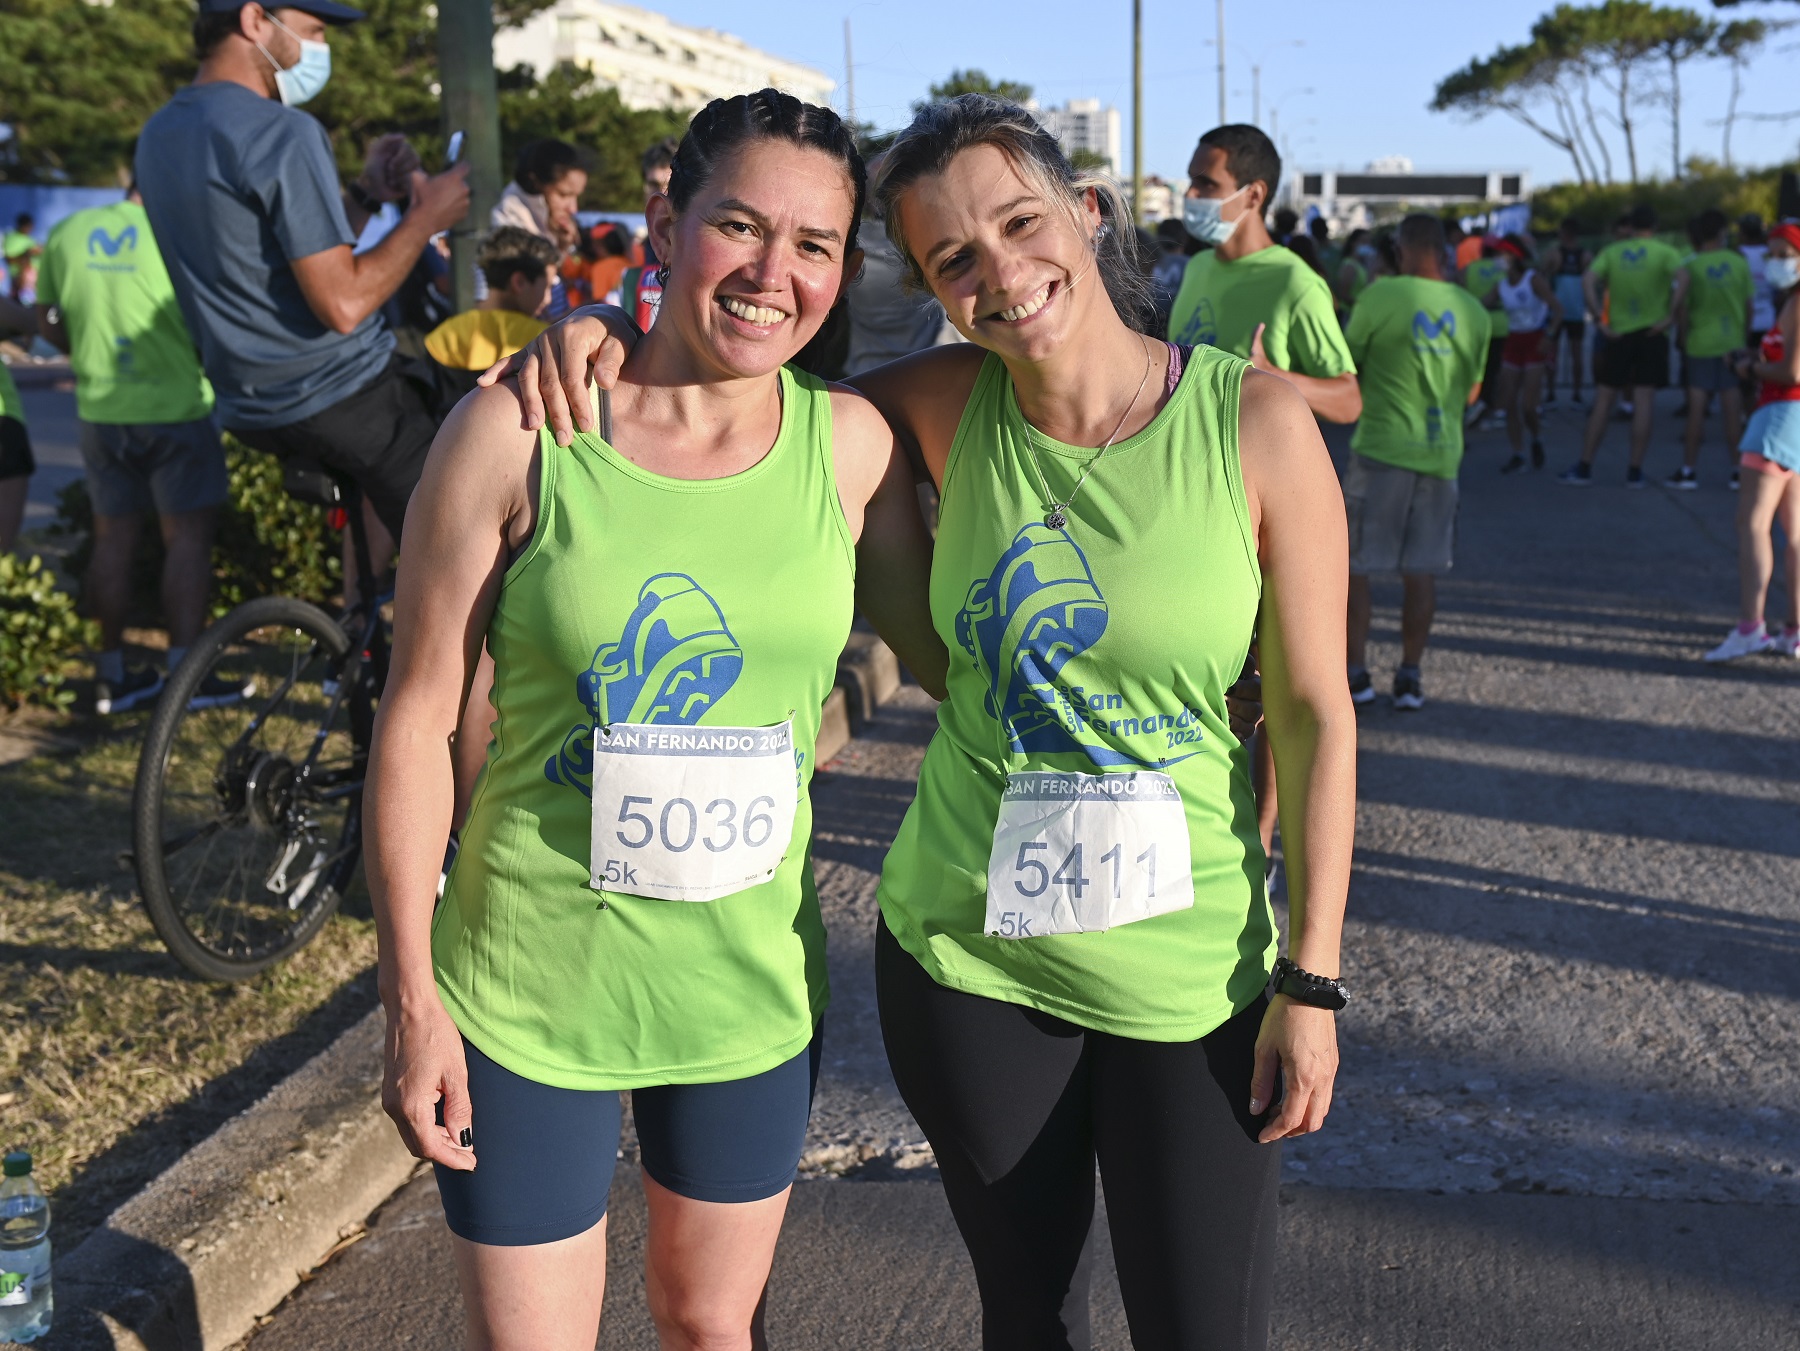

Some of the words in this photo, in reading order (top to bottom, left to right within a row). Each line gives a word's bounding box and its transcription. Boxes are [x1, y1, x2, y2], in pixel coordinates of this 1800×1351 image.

[1071, 686, 1123, 711] San
[1074, 702, 1203, 737] Fernando
[601, 732, 640, 748] SAN
[647, 733, 754, 750] FERNANDO
[1166, 726, 1204, 749] 2022
[1006, 780, 1035, 795] SAN
[1040, 780, 1139, 795] FERNANDO
[616, 795, 776, 852] 5036
[604, 859, 638, 886] 5k
[1014, 842, 1157, 899] 5411
[1000, 911, 1033, 937] 5k
